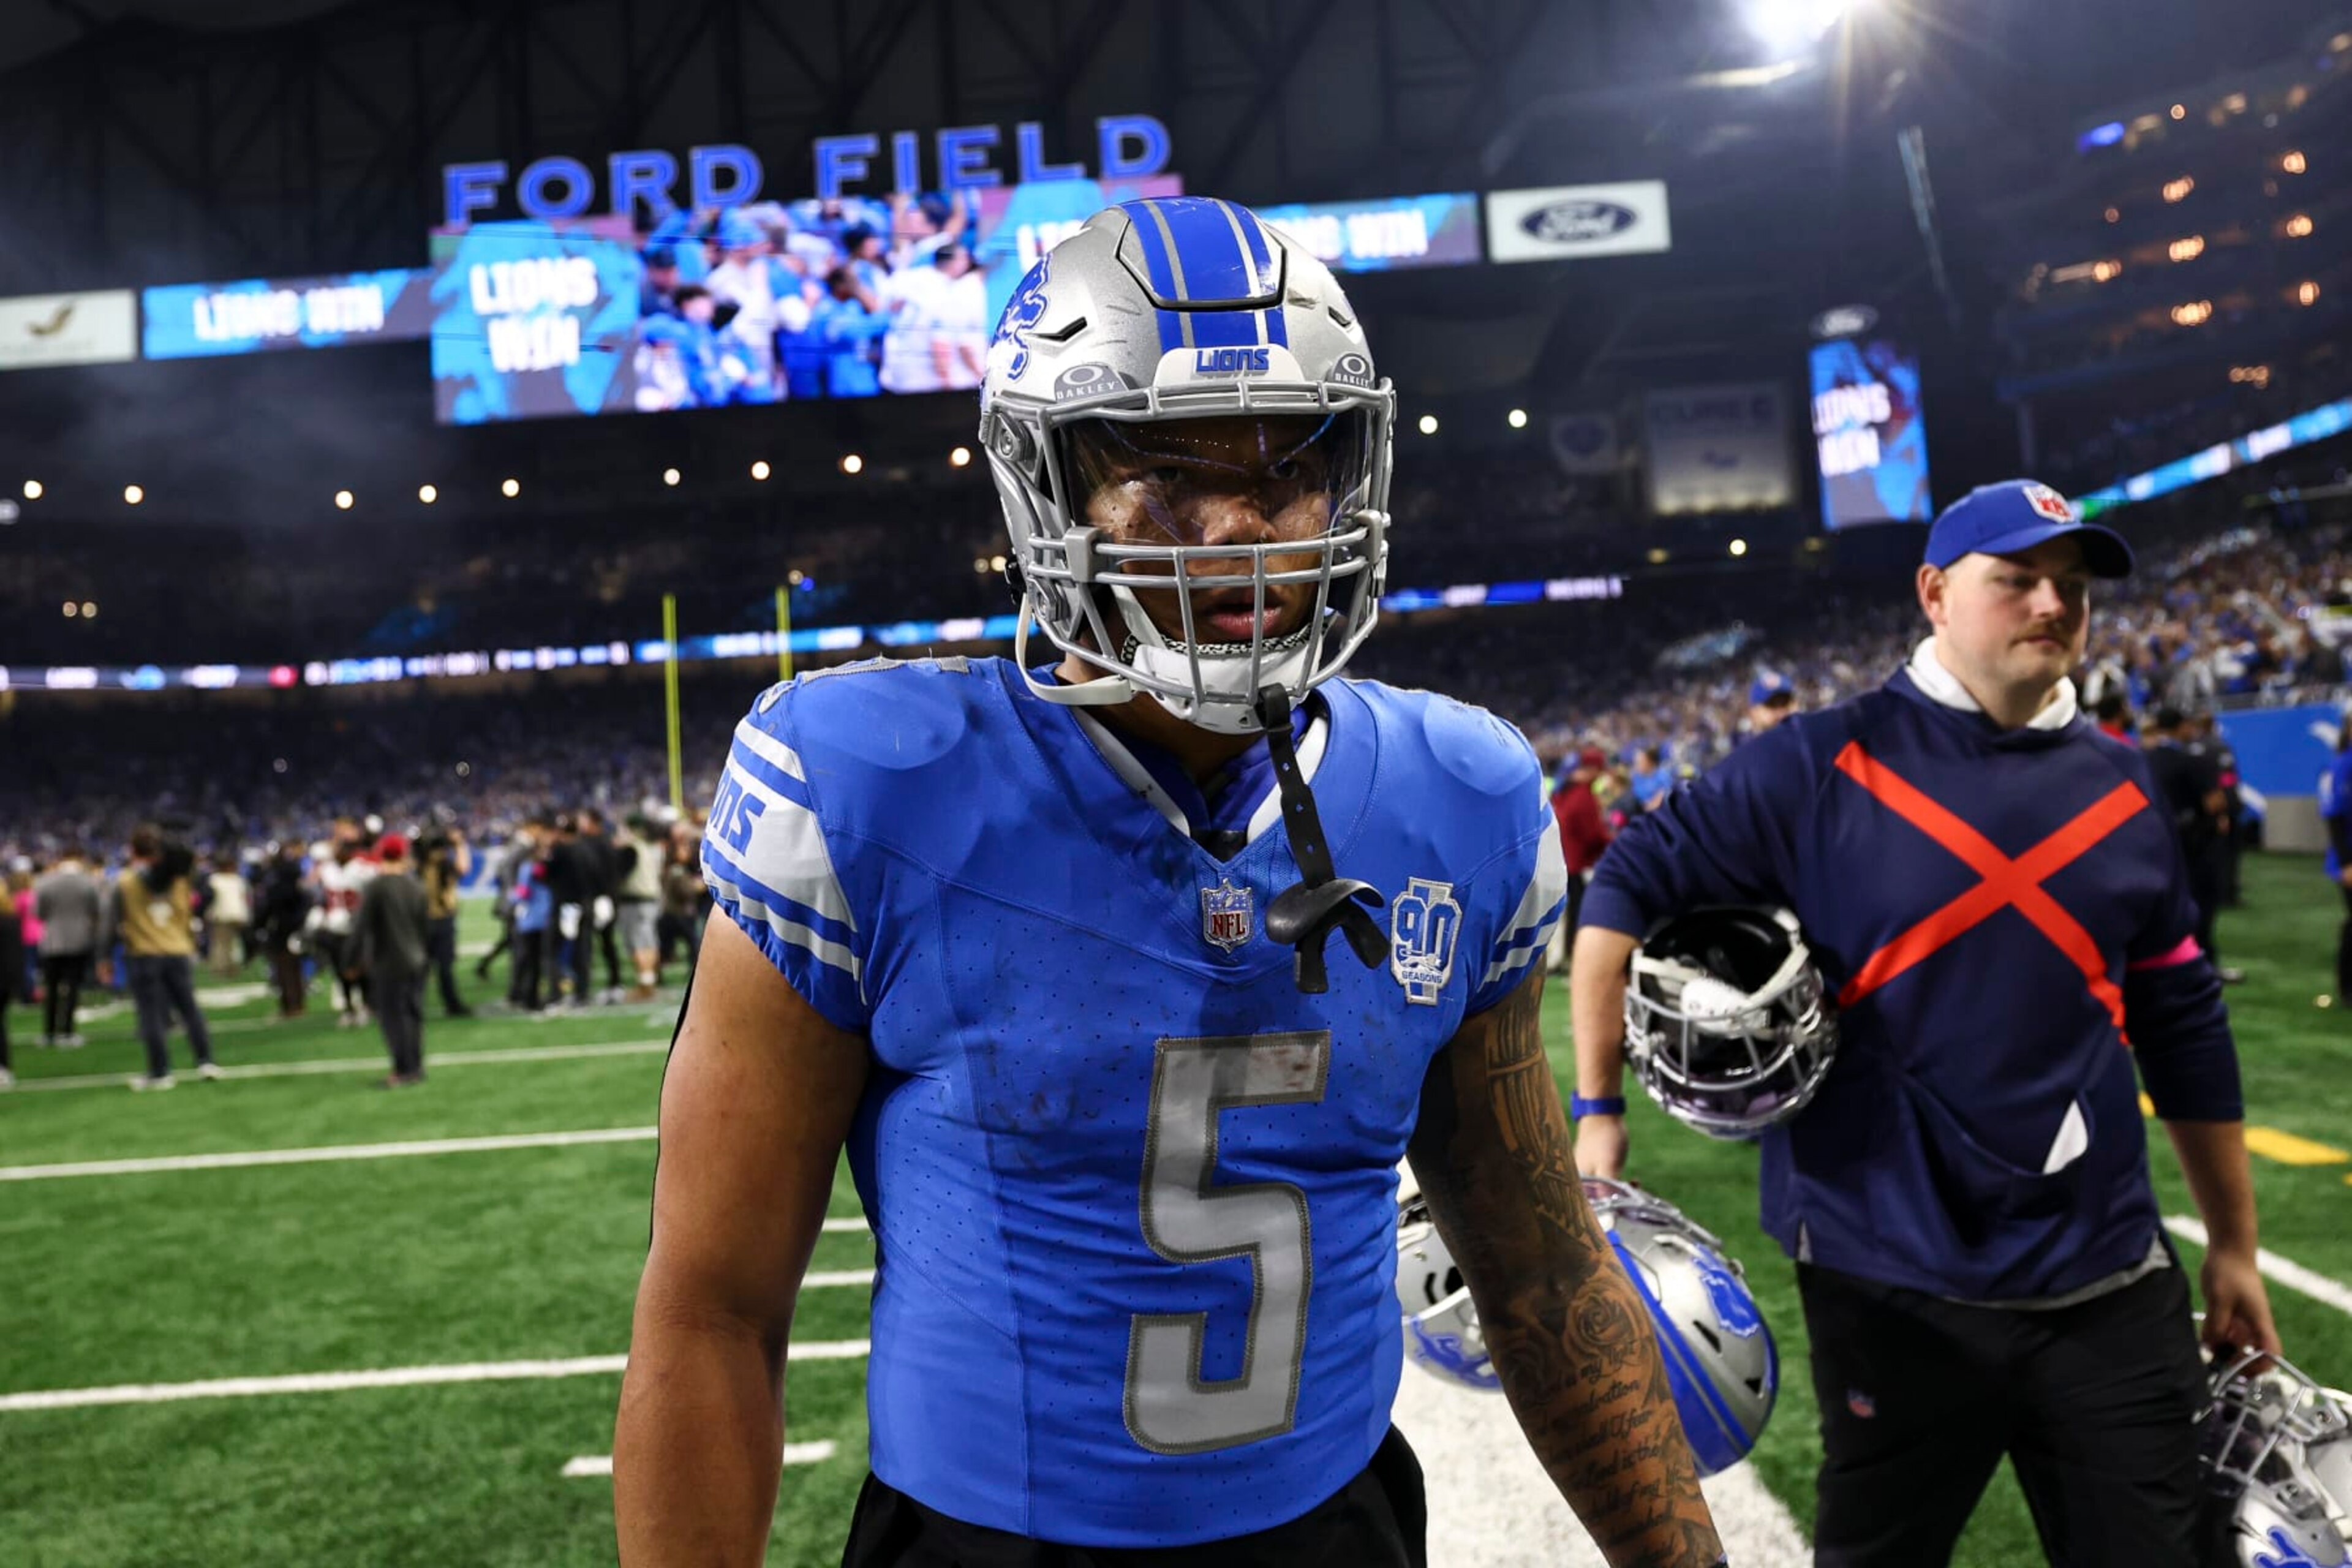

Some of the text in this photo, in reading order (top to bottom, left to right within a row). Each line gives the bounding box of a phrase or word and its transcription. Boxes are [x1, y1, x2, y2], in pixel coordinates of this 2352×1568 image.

[442, 114, 1172, 227] FORD FIELD
[470, 257, 598, 315] LIONS
[488, 314, 580, 372] WIN
[1196, 348, 1270, 372] LIONS
[1056, 380, 1116, 399] OAKLEY
[1335, 372, 1370, 388] OAKLEY
[1212, 913, 1246, 939] NFL
[1396, 897, 1457, 973] 90
[1401, 970, 1444, 983] SEASONS
[1123, 1030, 1332, 1454] 5
